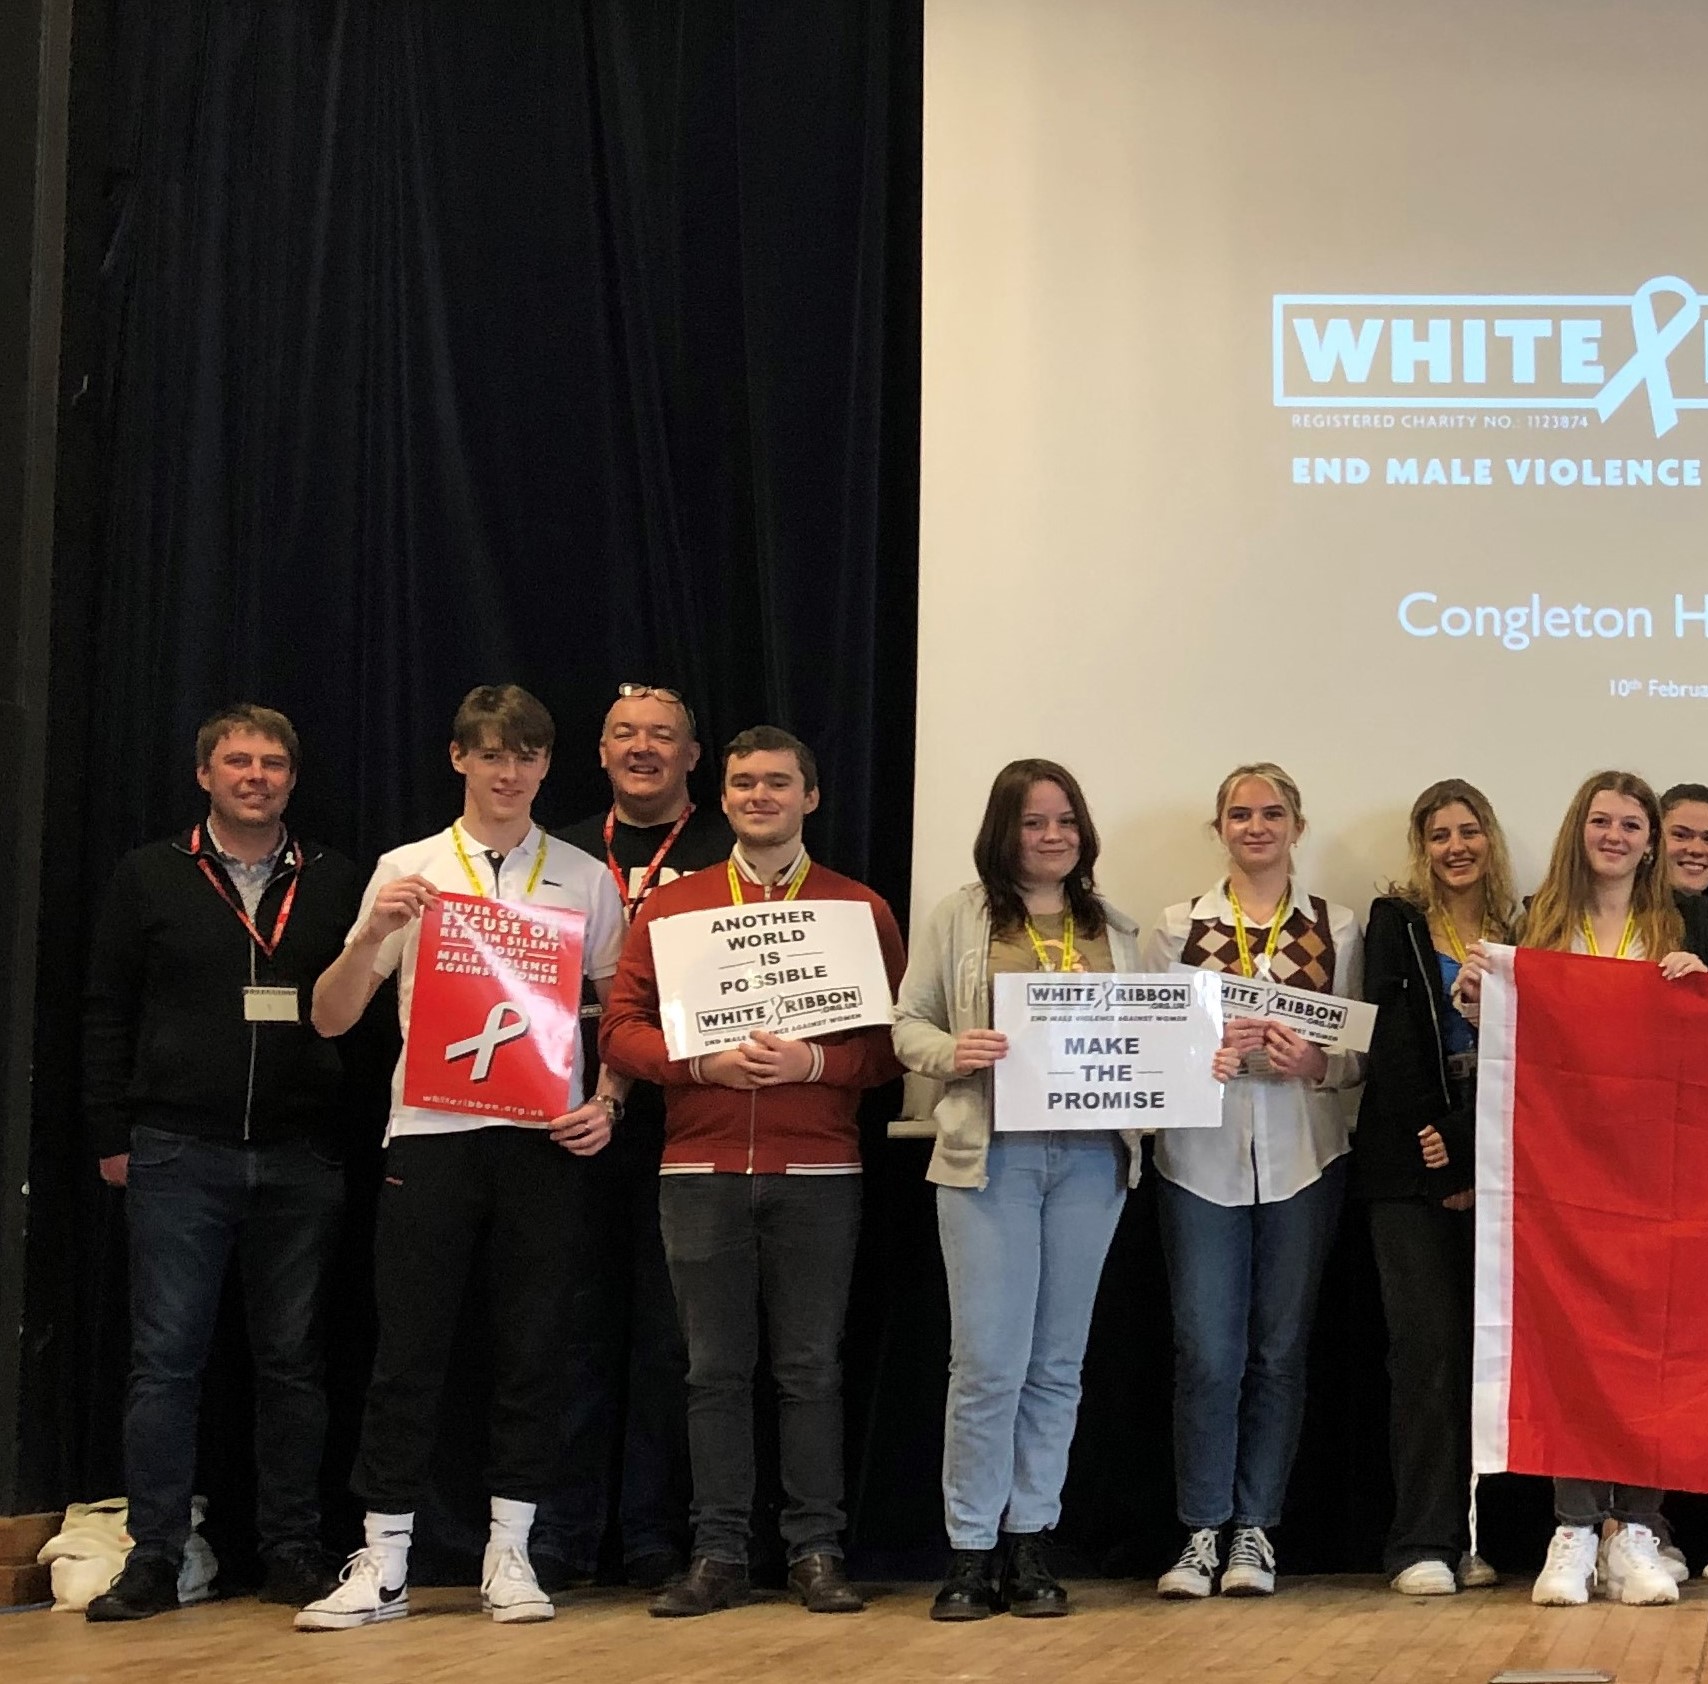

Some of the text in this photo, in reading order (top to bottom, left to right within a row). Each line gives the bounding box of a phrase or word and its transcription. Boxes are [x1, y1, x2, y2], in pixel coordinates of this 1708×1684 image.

[1293, 319, 1605, 384] WHITE
[1292, 414, 1396, 428] REGISTERED
[1401, 415, 1476, 429] CHARITY
[1527, 416, 1588, 429] 1123874
[1292, 457, 1370, 485] END
[1386, 458, 1492, 486] MALE
[1506, 458, 1702, 487] VIOLENCE
[1398, 592, 1653, 652] Congleton
[443, 900, 491, 917] NEVER
[442, 911, 521, 935] EXCUSE
[530, 924, 559, 941] OR
[711, 910, 816, 933] ANOTHER
[507, 935, 559, 952] SILENT
[727, 929, 806, 951] WORLD
[437, 950, 479, 964] MALE
[759, 951, 781, 966] IS
[720, 965, 828, 995] POSSIBLE
[1032, 988, 1185, 1002] WHITE RIBBON
[1222, 986, 1259, 1004] HITE
[1276, 997, 1343, 1023] RIBBON
[701, 990, 857, 1027] WHITE RIBBON
[1064, 1037, 1139, 1055] MAKE
[1080, 1064, 1133, 1081] THE
[1047, 1091, 1165, 1109] PROMISE
